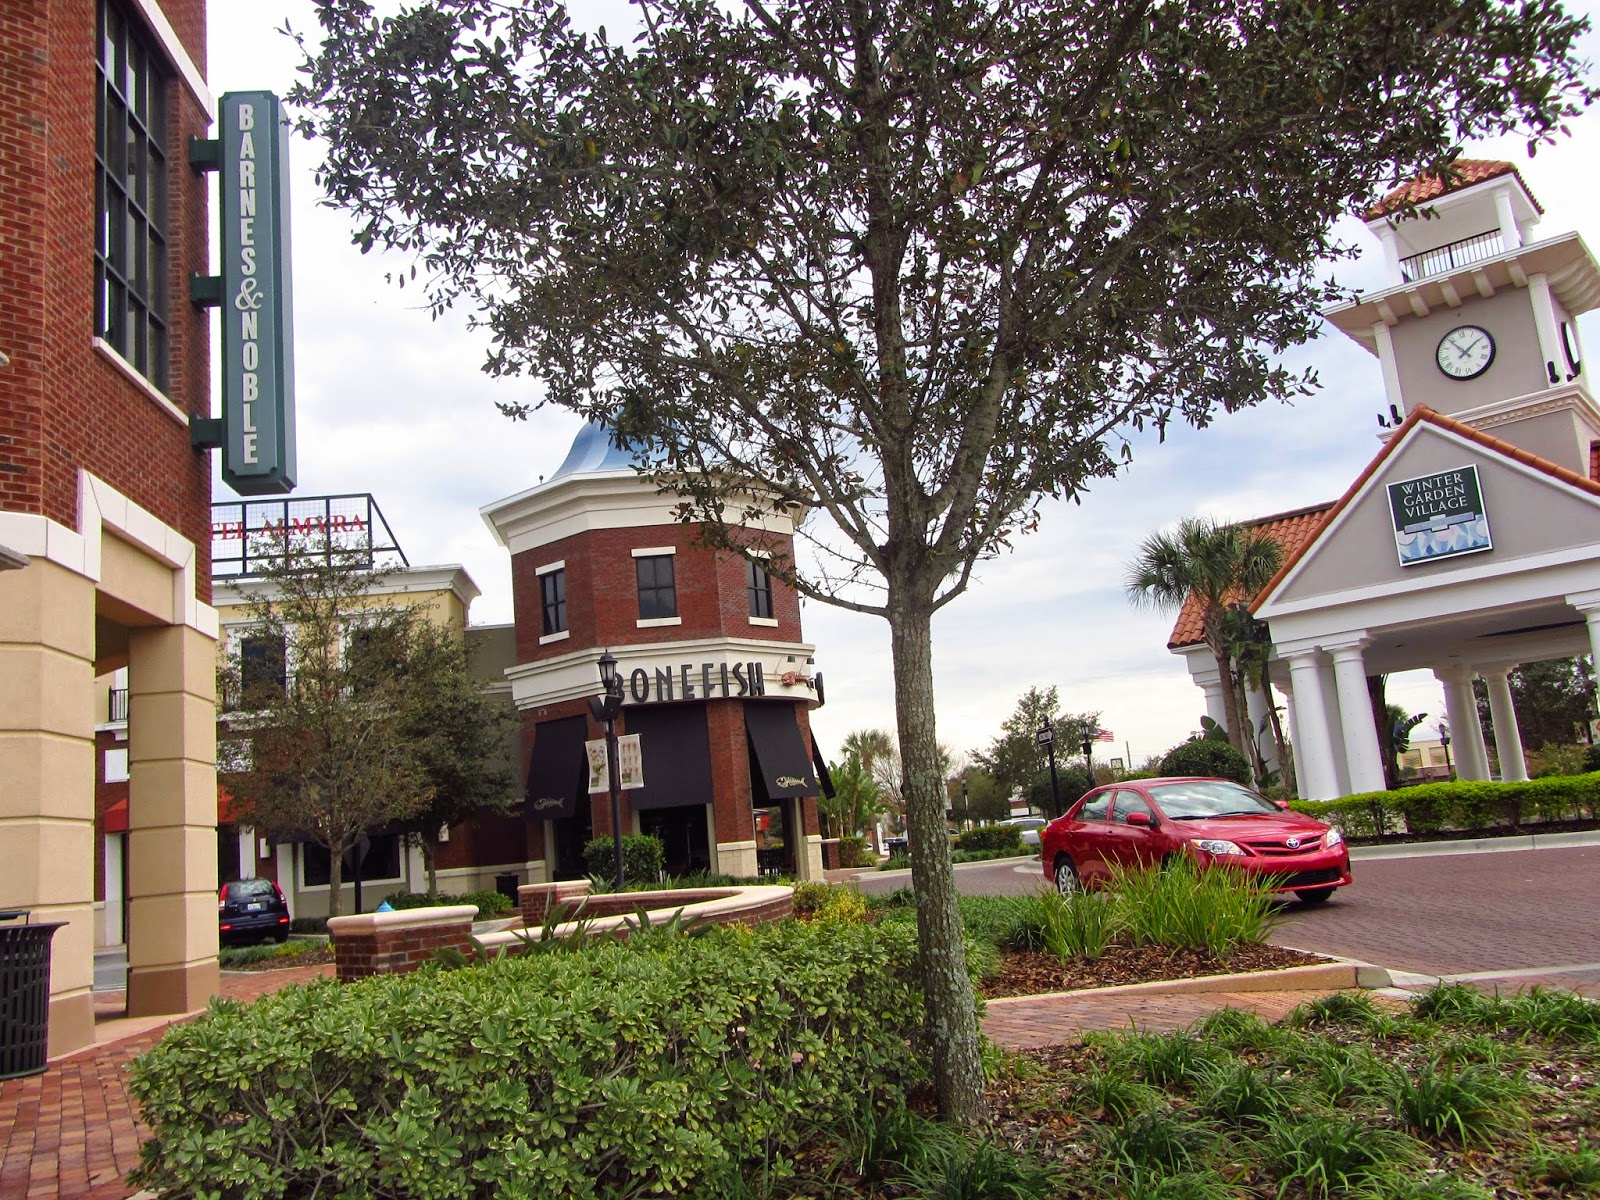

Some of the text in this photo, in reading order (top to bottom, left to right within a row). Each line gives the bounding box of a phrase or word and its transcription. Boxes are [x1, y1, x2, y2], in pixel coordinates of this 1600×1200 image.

[238, 103, 256, 276] BARNES
[241, 311, 259, 464] NOBLE
[1401, 472, 1463, 495] WINTER
[1403, 484, 1465, 507] GARDEN
[1405, 495, 1468, 518] VILLAGE
[260, 513, 366, 538] ALMYRA
